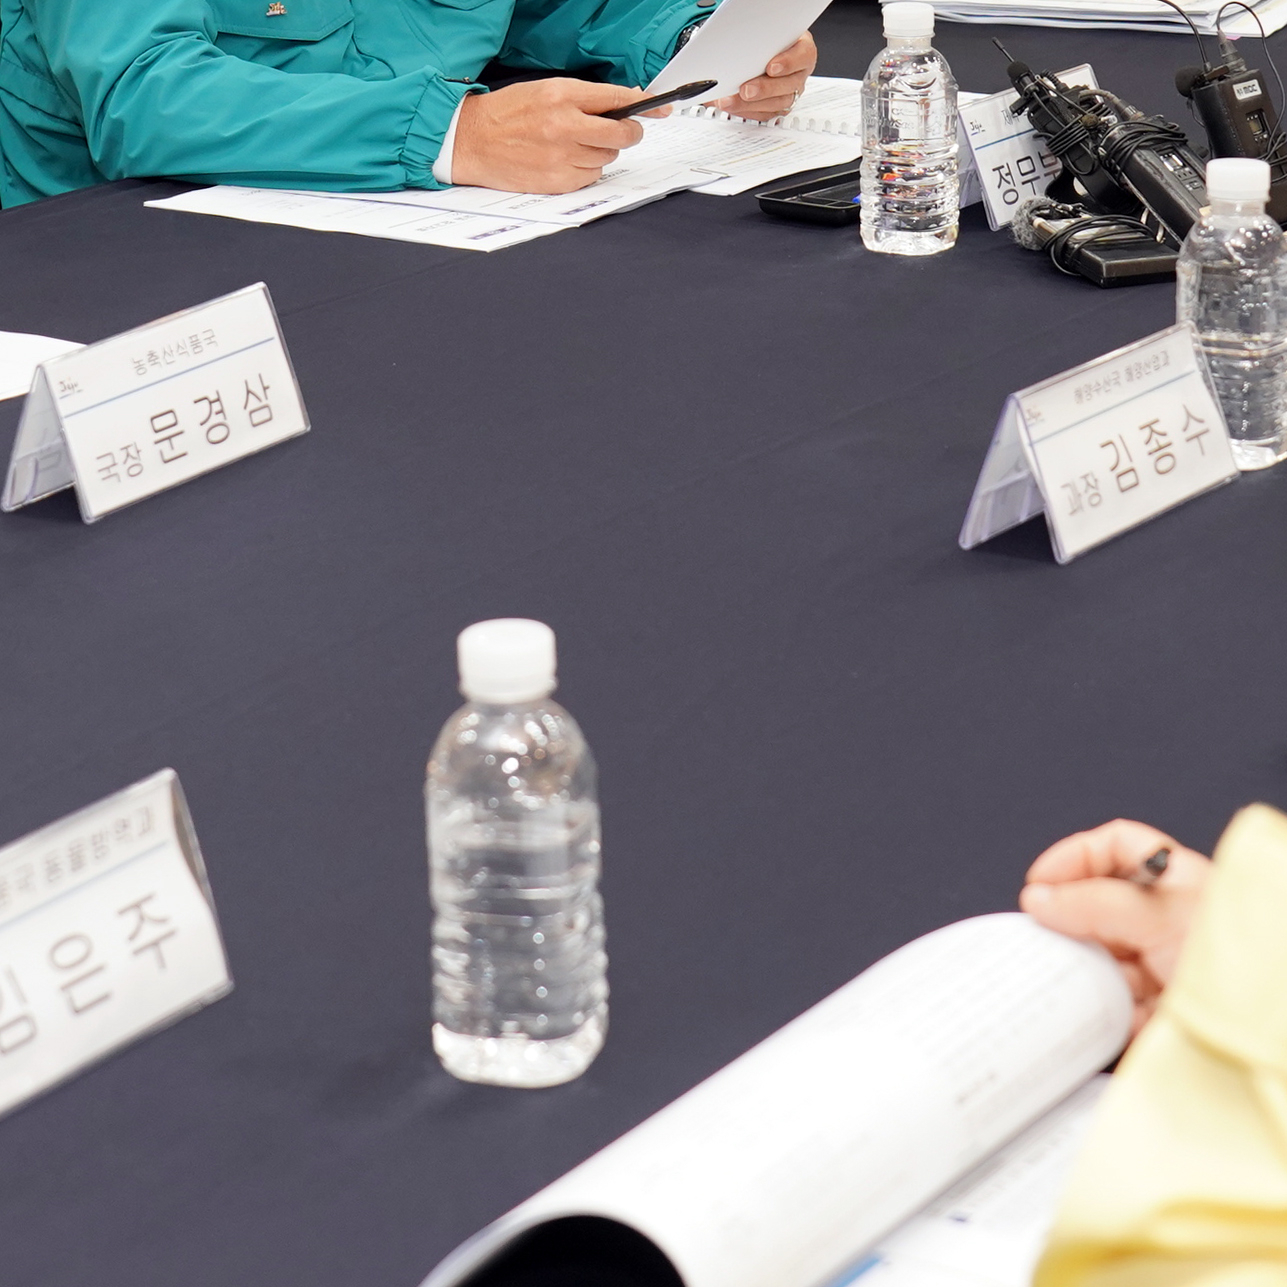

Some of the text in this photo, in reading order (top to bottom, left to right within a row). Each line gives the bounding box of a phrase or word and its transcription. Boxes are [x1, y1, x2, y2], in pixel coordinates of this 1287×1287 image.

[131, 328, 219, 376] 농축산식품국
[95, 372, 274, 484] 국장 문경삼
[1061, 403, 1210, 516] 과장 김종수
